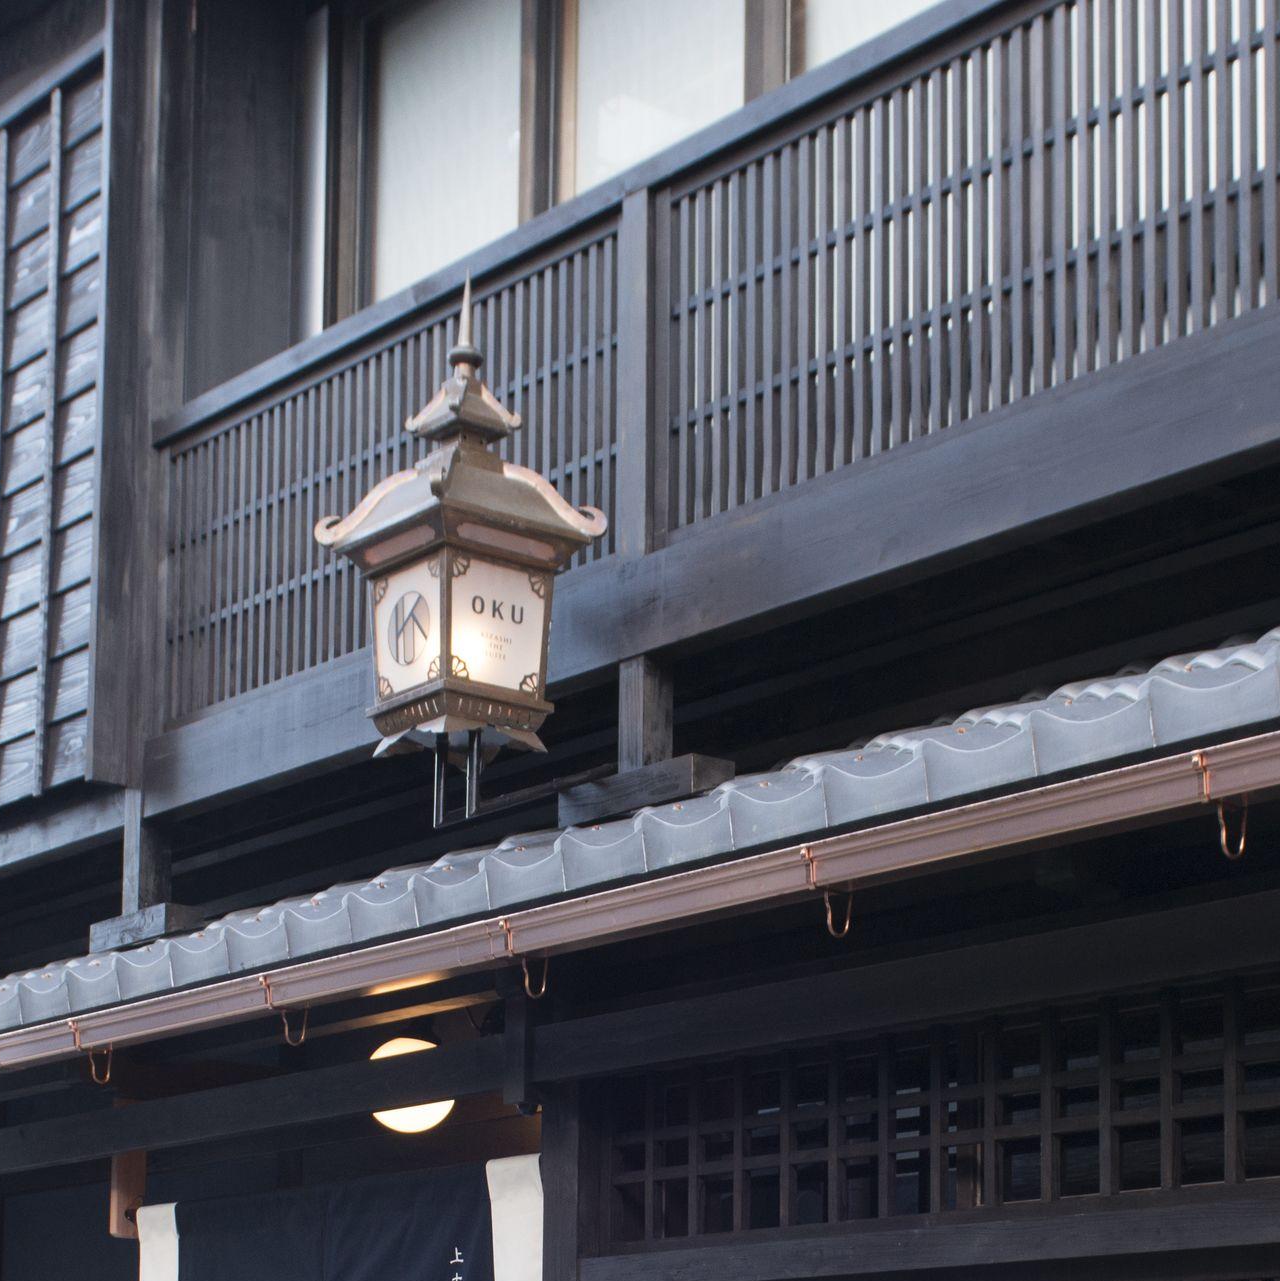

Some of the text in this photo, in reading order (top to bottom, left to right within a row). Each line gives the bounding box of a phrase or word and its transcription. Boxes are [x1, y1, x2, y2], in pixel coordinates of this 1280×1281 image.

[472, 595, 524, 625] OKU
[480, 631, 513, 645] KIZASHI
[489, 642, 503, 651] THE
